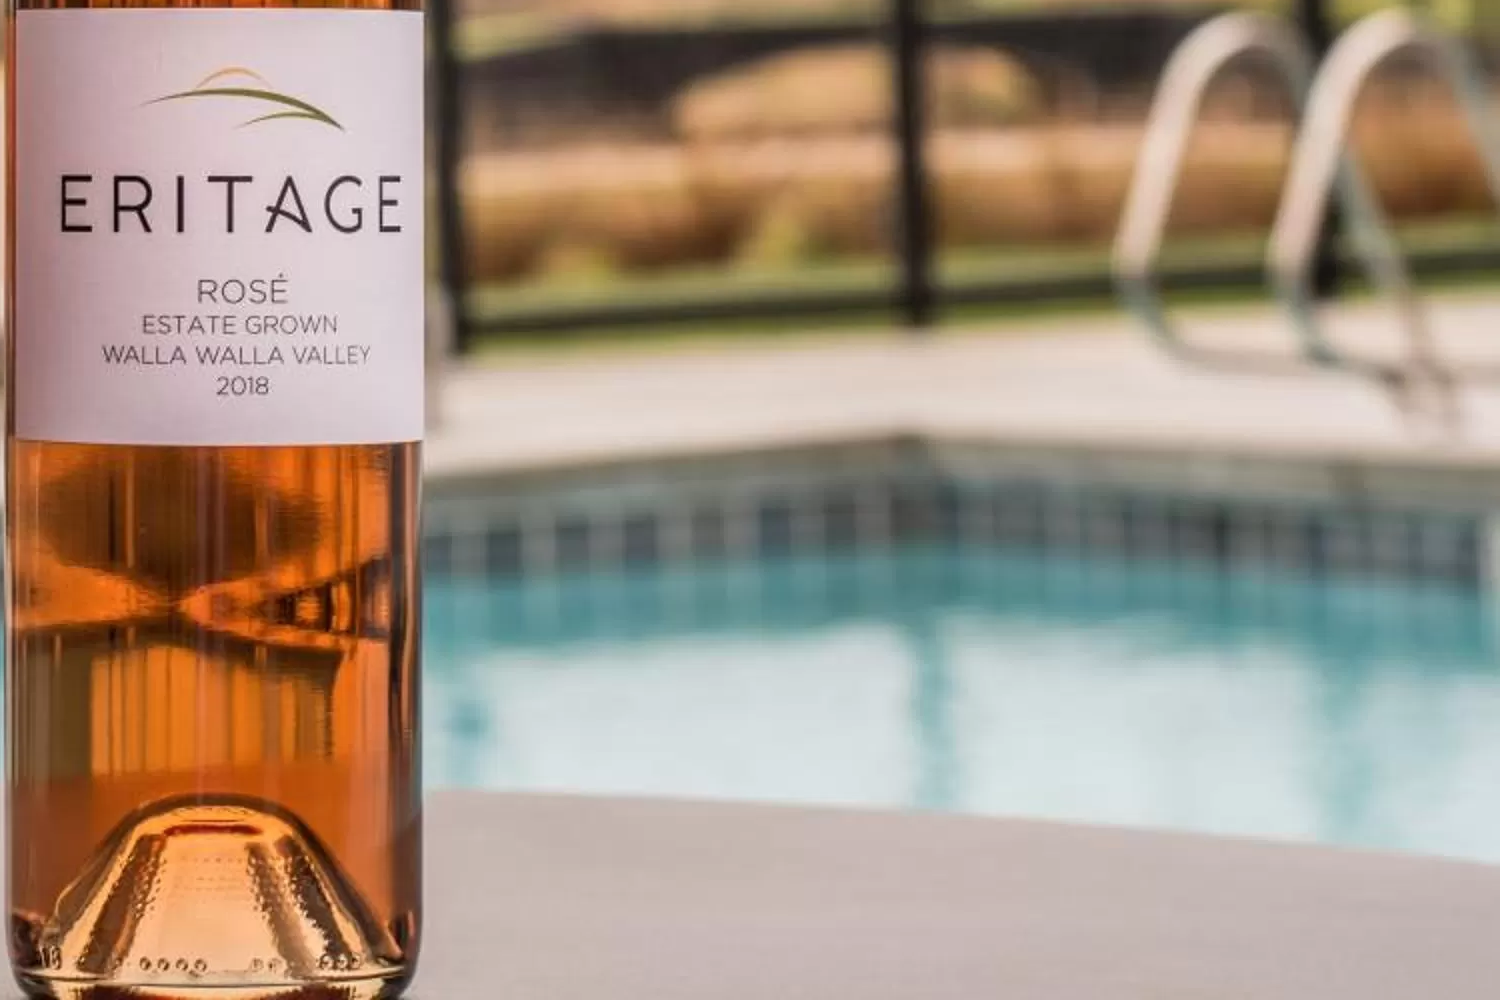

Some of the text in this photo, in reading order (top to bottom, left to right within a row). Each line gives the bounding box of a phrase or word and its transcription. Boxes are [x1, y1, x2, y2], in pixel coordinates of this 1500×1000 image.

[60, 174, 403, 235] ERITAGE
[197, 272, 289, 304] ROSÉ
[142, 314, 338, 336] ESTATE GROWN
[102, 344, 371, 366] WALLA WALLA VALLEY
[215, 375, 270, 397] 2018
